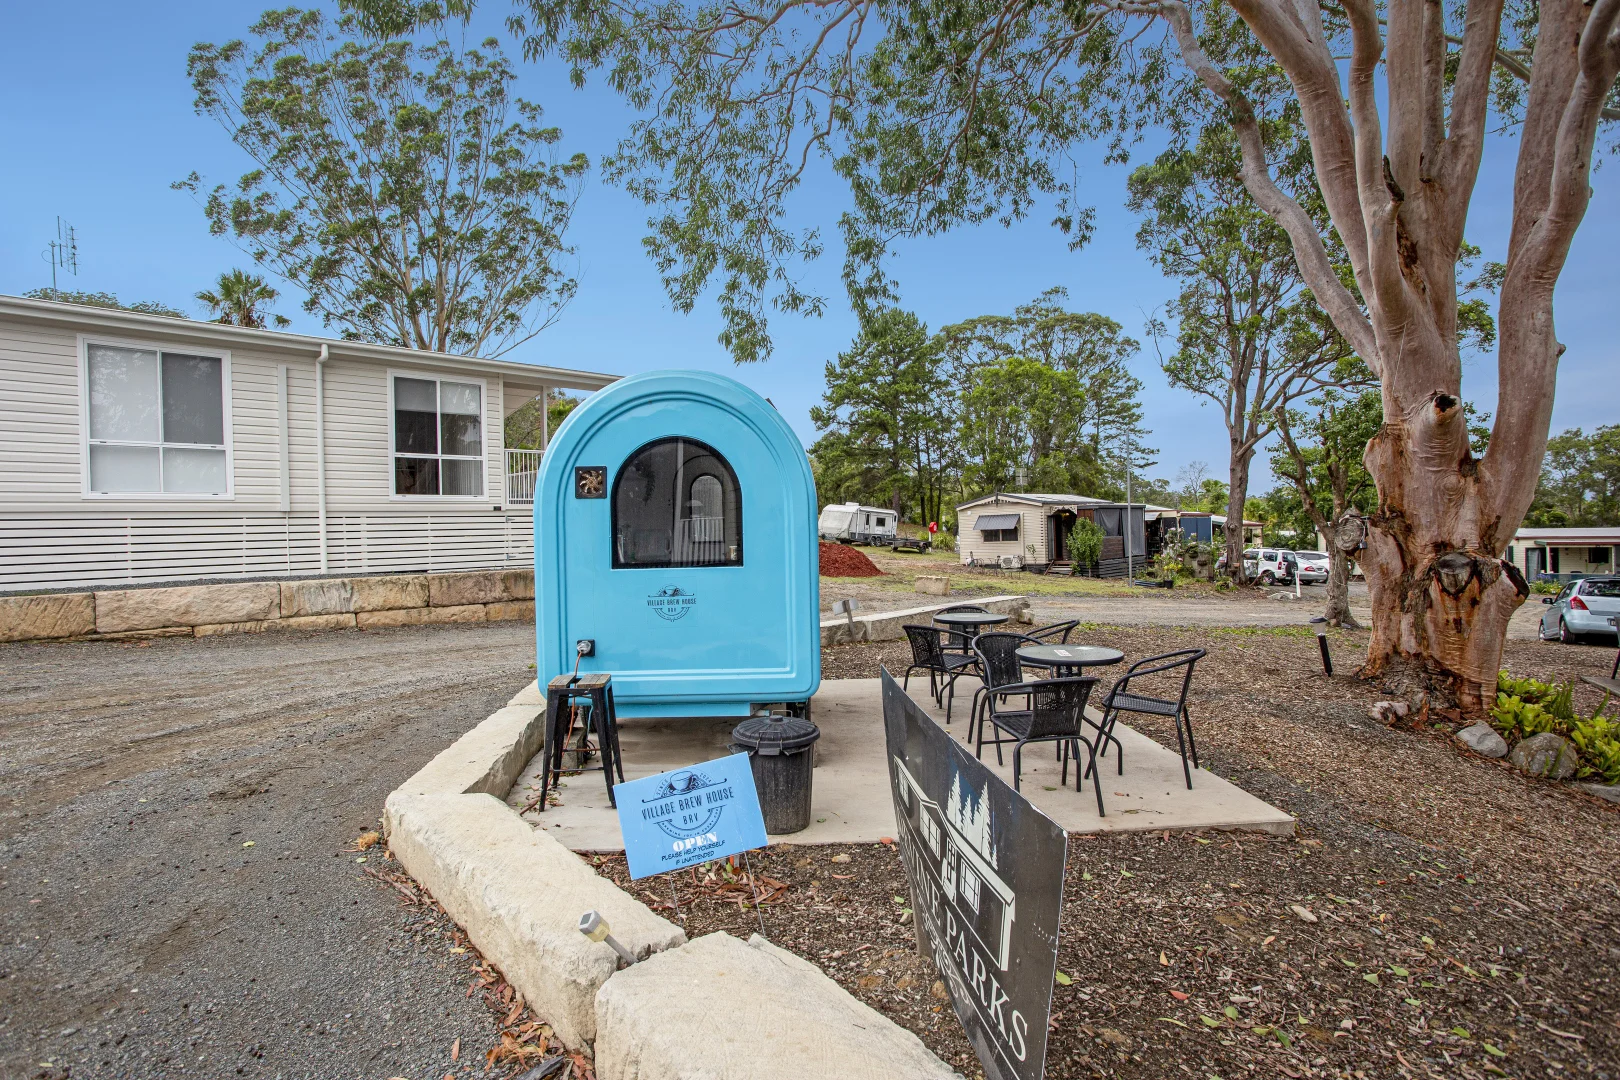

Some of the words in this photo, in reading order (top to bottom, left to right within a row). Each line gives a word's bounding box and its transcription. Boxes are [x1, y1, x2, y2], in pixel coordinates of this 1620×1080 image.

[656, 778, 669, 796] SINCE
[641, 801, 676, 820] VILLAGE
[678, 794, 702, 811] BREW
[706, 787, 735, 804] HOUSE
[683, 812, 698, 825] BRV
[661, 851, 683, 861] PLEASE
[683, 847, 697, 856] HELP
[697, 840, 725, 852] YOURSELF
[672, 831, 718, 852] OPEN
[681, 850, 715, 864] UNATTENDED
[945, 904, 1029, 1062] PARKS
